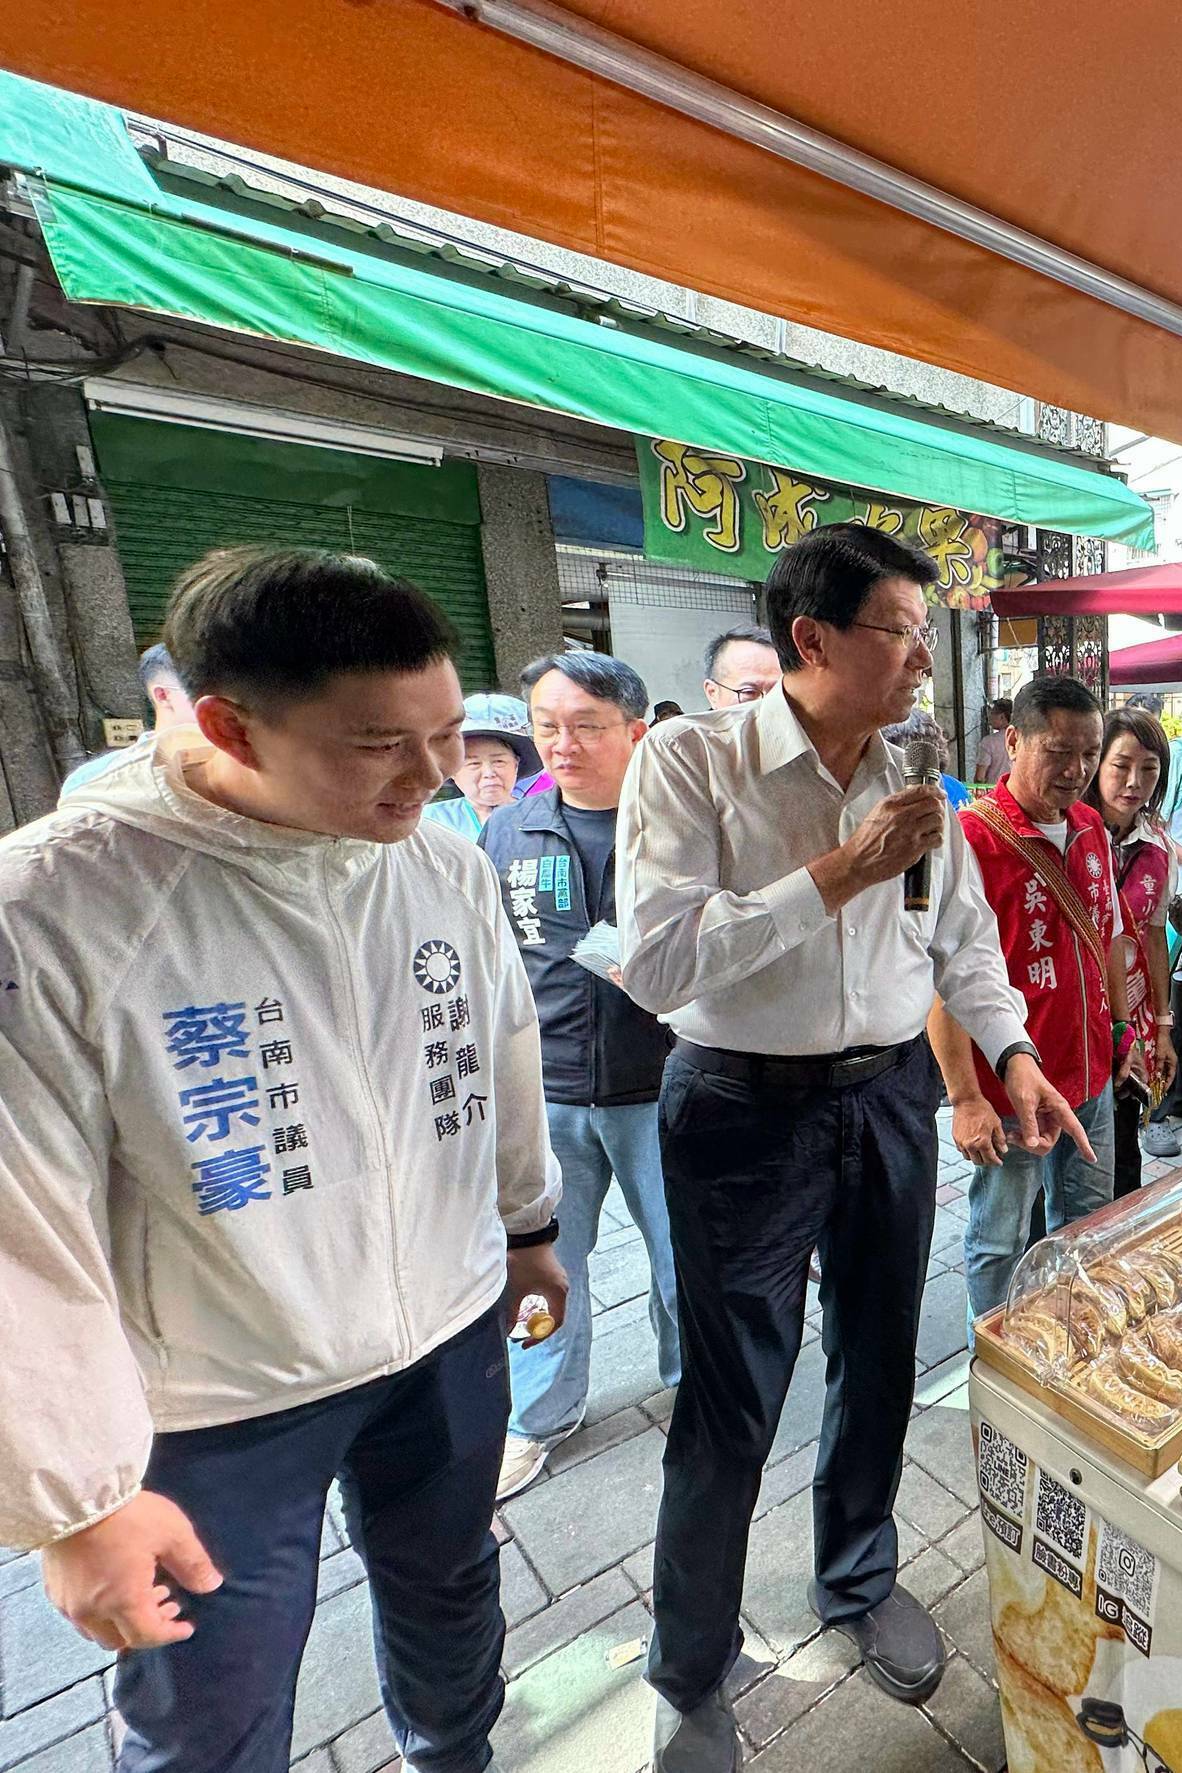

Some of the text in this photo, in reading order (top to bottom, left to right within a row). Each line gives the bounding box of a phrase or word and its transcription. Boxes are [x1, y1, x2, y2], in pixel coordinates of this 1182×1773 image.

[507, 858, 546, 946] 楊家宜
[1023, 876, 1059, 990] 吳東明
[162, 1001, 272, 1217] 蔡宗豪
[254, 997, 315, 1196] 台南市議員
[420, 1003, 462, 1142] 服務團隊
[447, 993, 488, 1126] 謝龍介
[1034, 1542, 1082, 1592] 臉書粉專
[1097, 1594, 1119, 1620] IG
